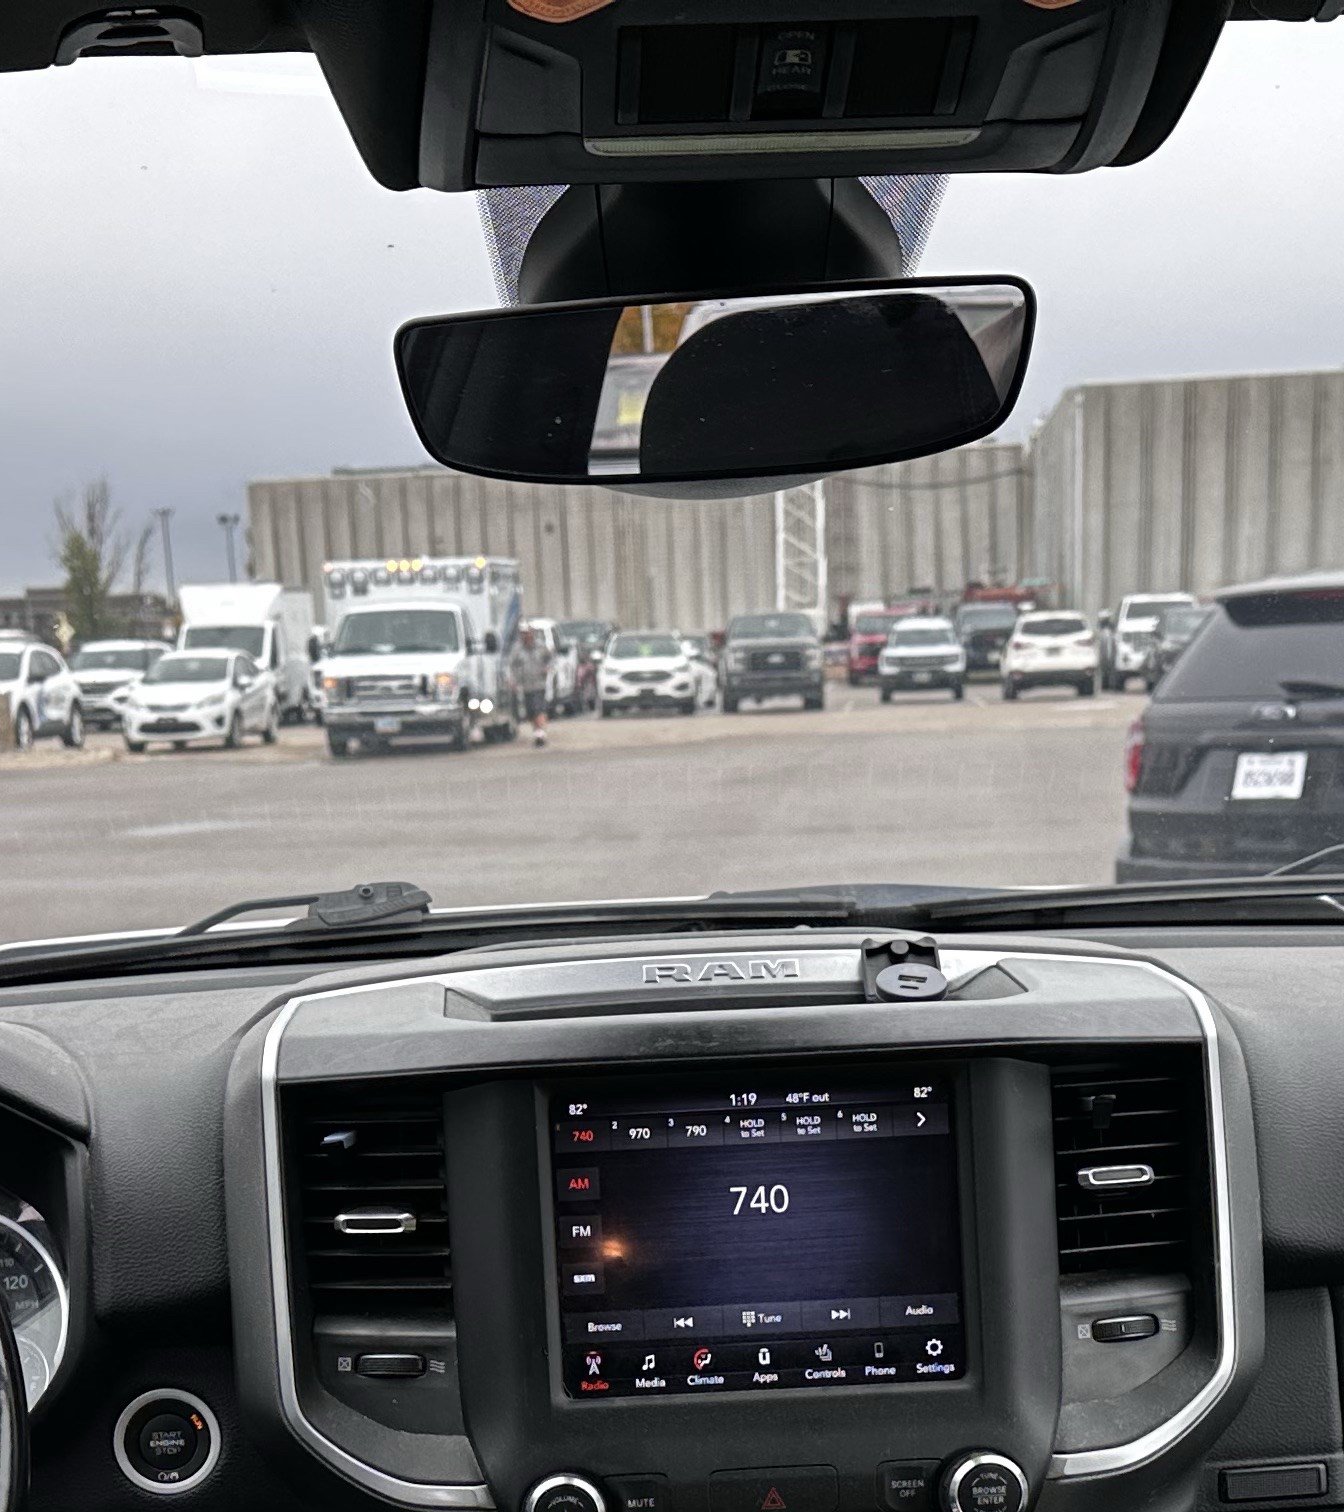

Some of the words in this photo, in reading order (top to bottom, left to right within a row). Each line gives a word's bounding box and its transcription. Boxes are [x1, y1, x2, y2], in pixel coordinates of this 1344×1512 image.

[642, 958, 799, 983] RAM
[913, 1086, 932, 1099] 82°
[729, 1093, 757, 1107] 1:19
[786, 1092, 810, 1104] 48°F
[812, 1092, 830, 1103] out
[568, 1104, 588, 1116] 82°
[740, 1118, 765, 1128] HOLD
[796, 1116, 821, 1126] HOLD
[852, 1113, 877, 1123] HOLD
[612, 1121, 618, 1130] 2
[629, 1127, 651, 1140] 970
[668, 1119, 674, 1127] 3
[685, 1125, 707, 1138] 790
[808, 1125, 821, 1135] Set
[864, 1122, 877, 1132] Set
[571, 1130, 594, 1142] 740
[751, 1128, 765, 1138] Set
[568, 1178, 589, 1190] AM
[729, 1184, 789, 1216] 740
[571, 1225, 591, 1237] FM
[2, 1274, 29, 1291] 120
[905, 1305, 933, 1316] Audio
[757, 1313, 782, 1324] Tune
[587, 1321, 622, 1333] Browse
[581, 1380, 609, 1391] Radio
[635, 1377, 666, 1389] Media
[687, 1373, 725, 1386] Climate
[753, 1372, 778, 1384] Apps
[805, 1368, 846, 1380] Controls
[865, 1365, 896, 1376] Phone
[916, 1361, 955, 1375] Settings
[152, 1431, 182, 1439] START
[149, 1439, 186, 1448] ENGINE
[890, 1480, 924, 1489] SCREEN
[972, 1485, 1007, 1495] BROWSE
[899, 1490, 916, 1498] OFF
[627, 1497, 655, 1508] MUTE
[977, 1496, 1004, 1505] ENTER
